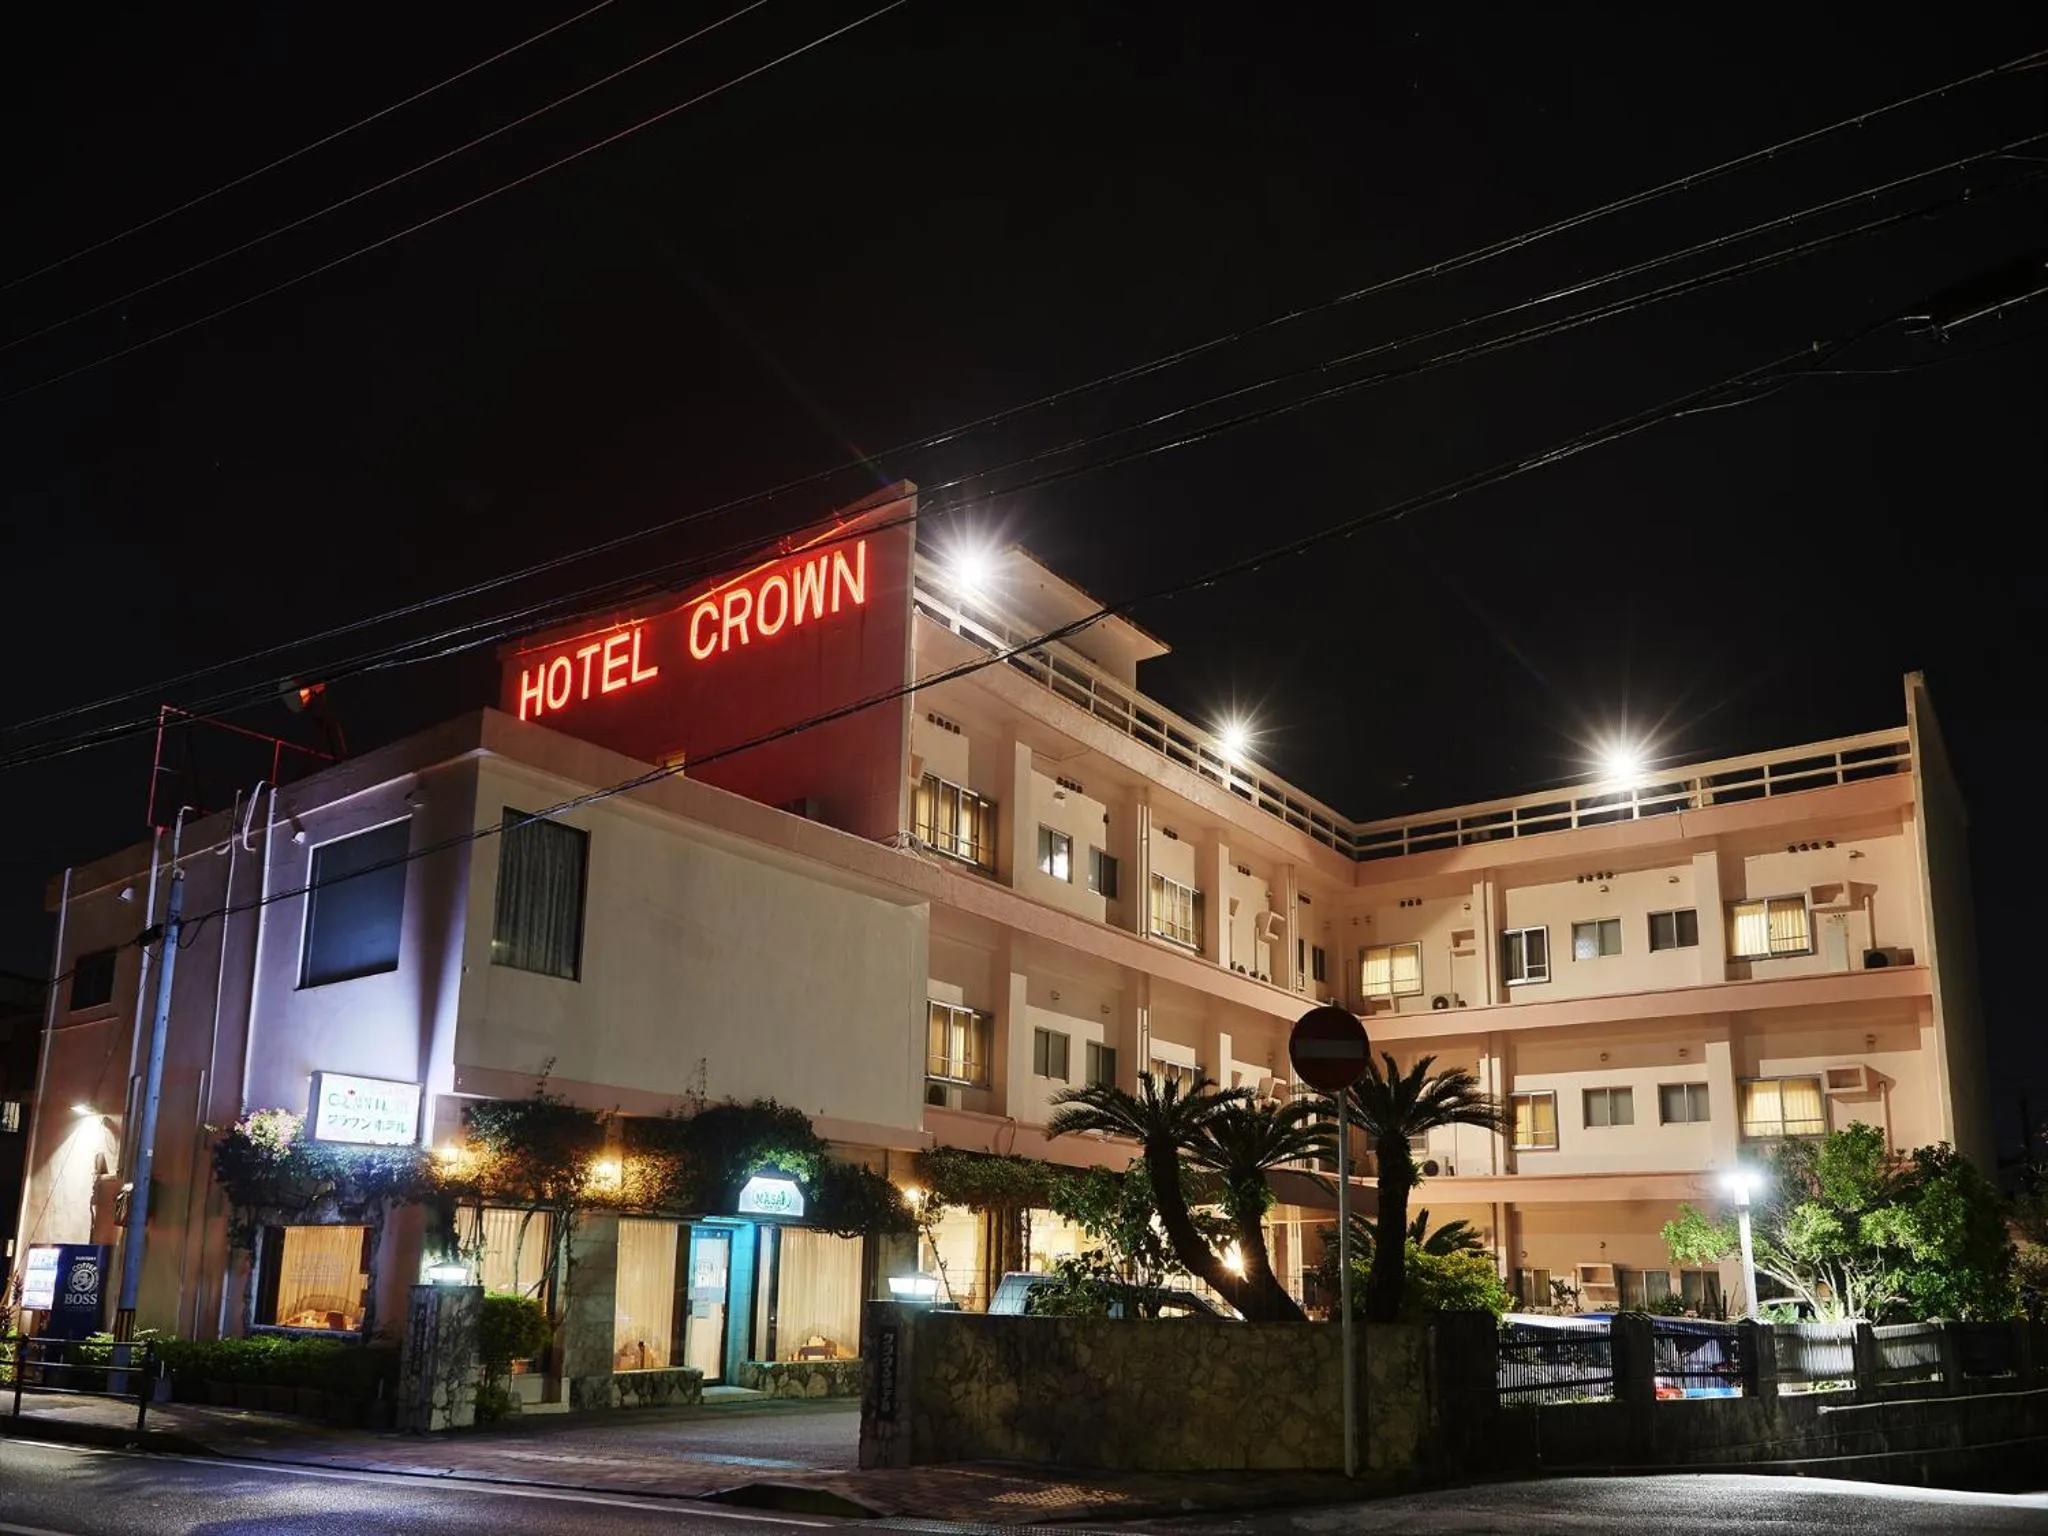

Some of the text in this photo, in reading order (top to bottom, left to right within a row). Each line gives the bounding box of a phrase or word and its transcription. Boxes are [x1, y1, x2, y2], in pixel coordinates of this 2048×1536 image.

[519, 539, 867, 721] HOTEL CROWN
[64, 1294, 98, 1305] BOSS
